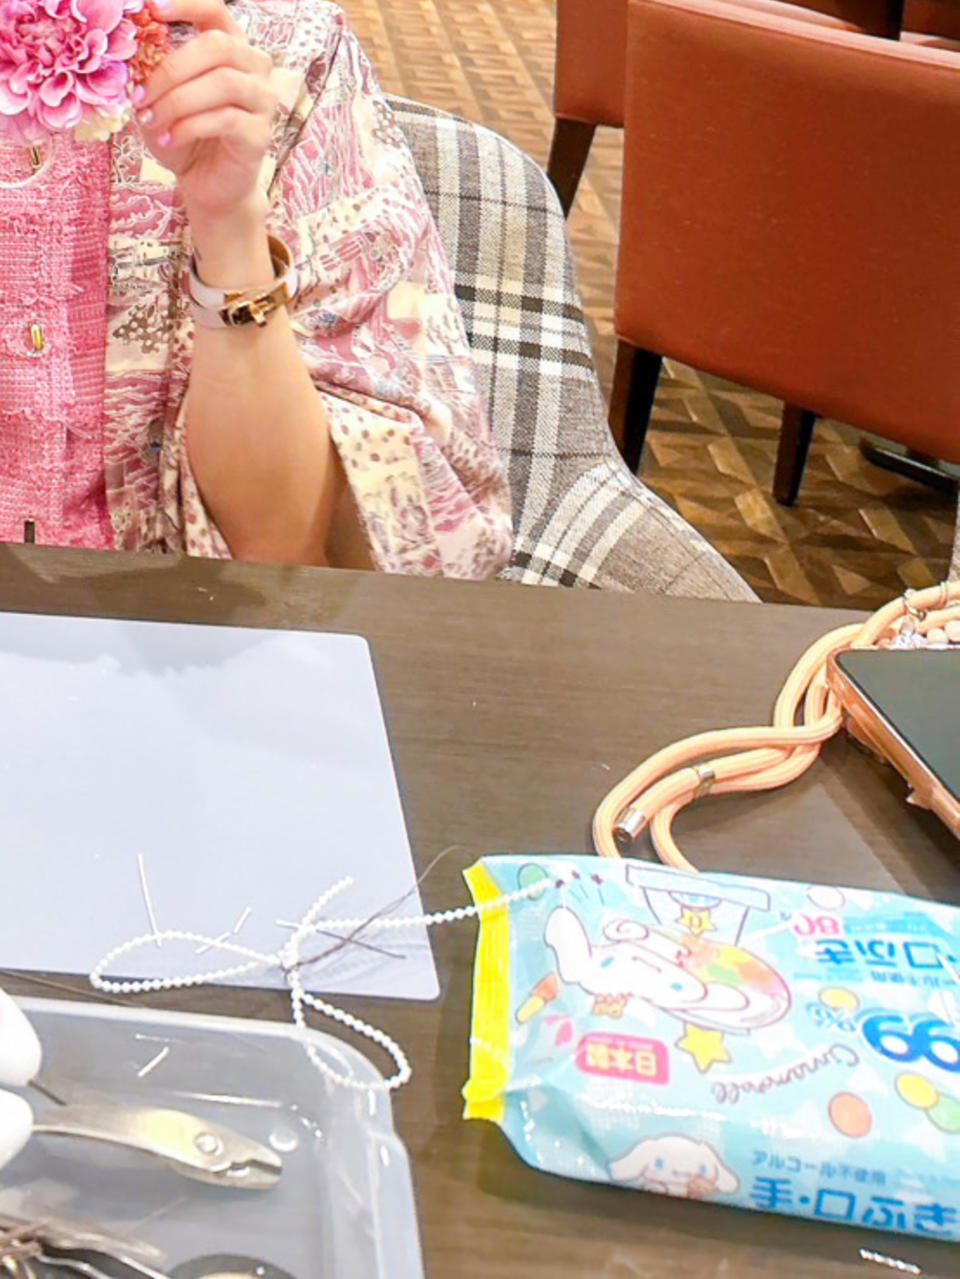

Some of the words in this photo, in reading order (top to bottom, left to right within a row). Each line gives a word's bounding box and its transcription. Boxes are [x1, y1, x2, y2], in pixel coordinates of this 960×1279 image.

[585, 1043, 658, 1077] 日本製
[751, 1150, 887, 1185] アルコール不使用
[749, 1175, 957, 1236] 手・口ふき
